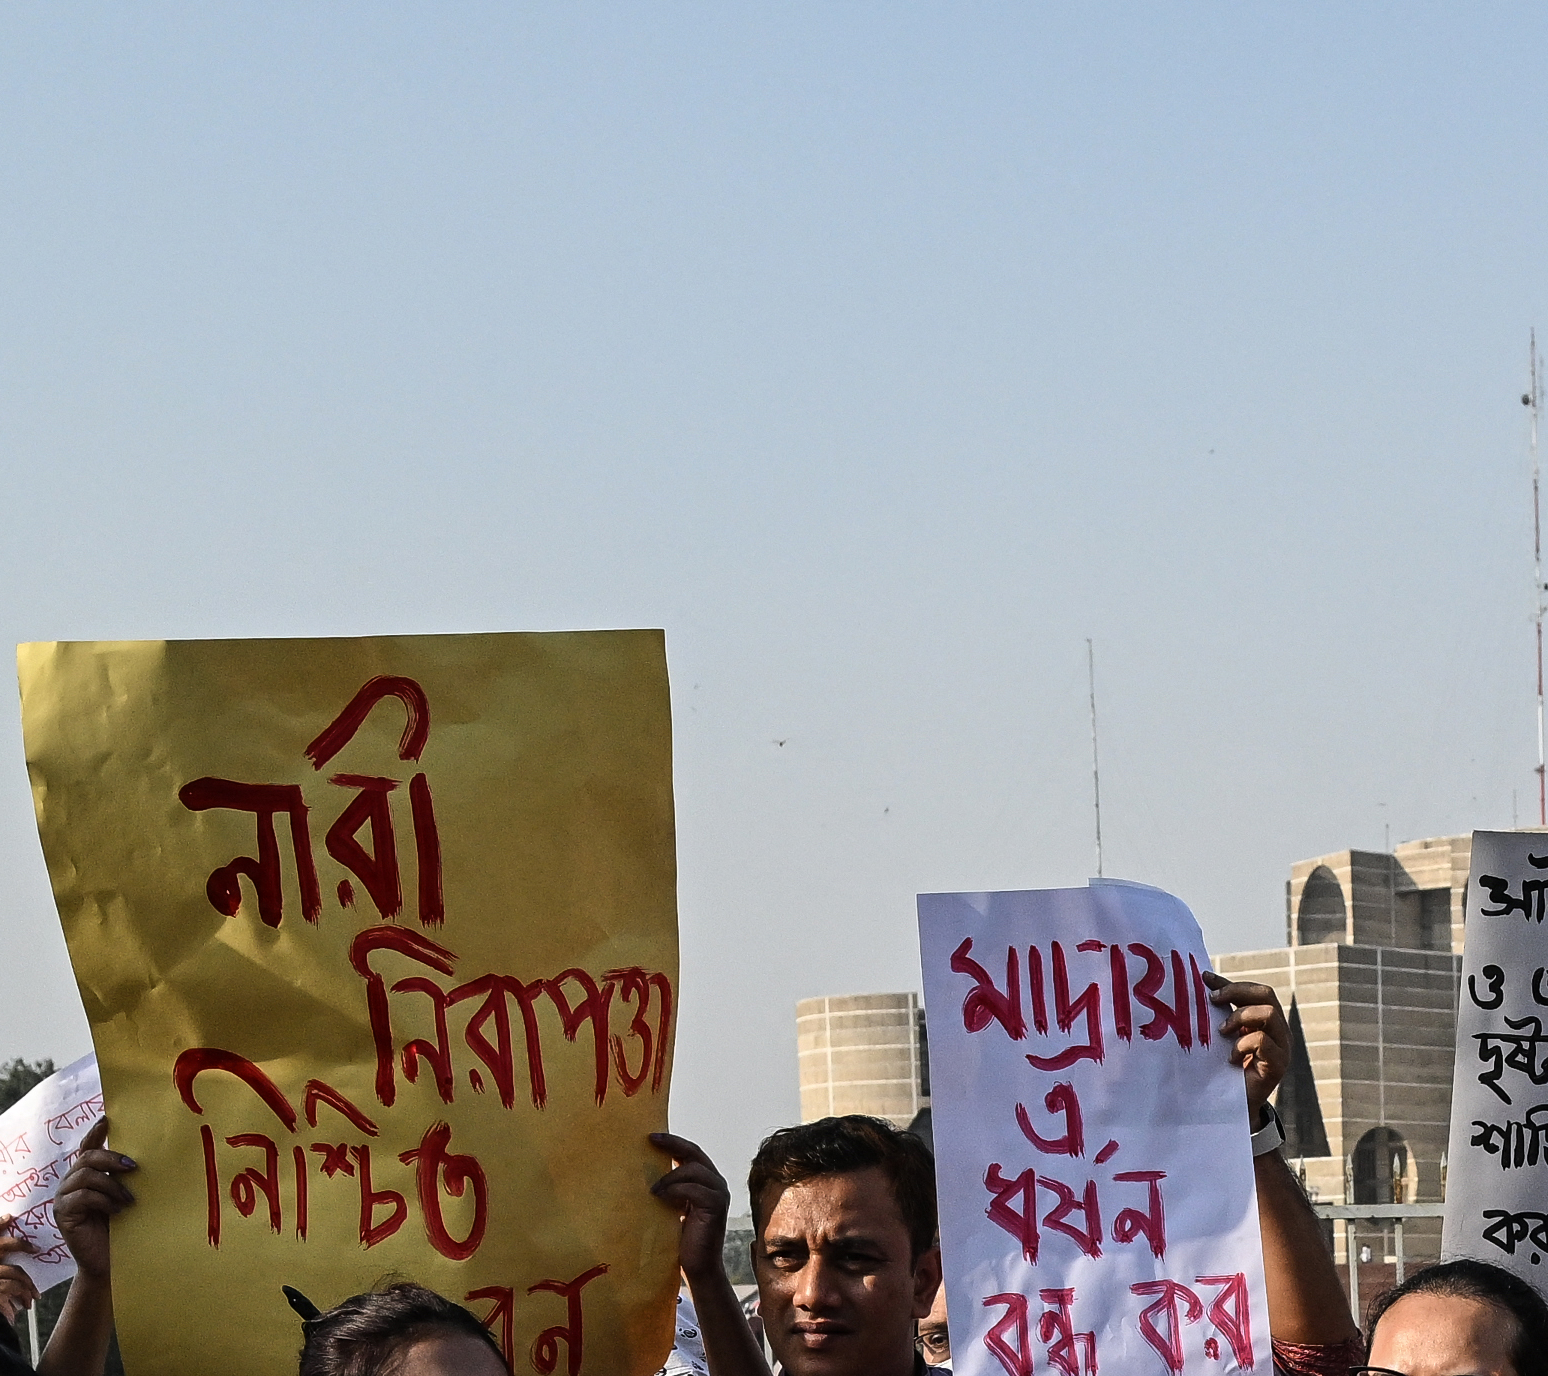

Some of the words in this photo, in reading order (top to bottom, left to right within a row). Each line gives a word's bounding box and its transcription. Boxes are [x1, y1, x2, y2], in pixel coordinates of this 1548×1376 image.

[178, 674, 445, 928] নারী
[349, 925, 673, 1111] নিরাপত্তা
[1469, 964, 1505, 1010] ও
[173, 1047, 488, 1261] নিশ্চিত
[1014, 1080, 1085, 1158] এ
